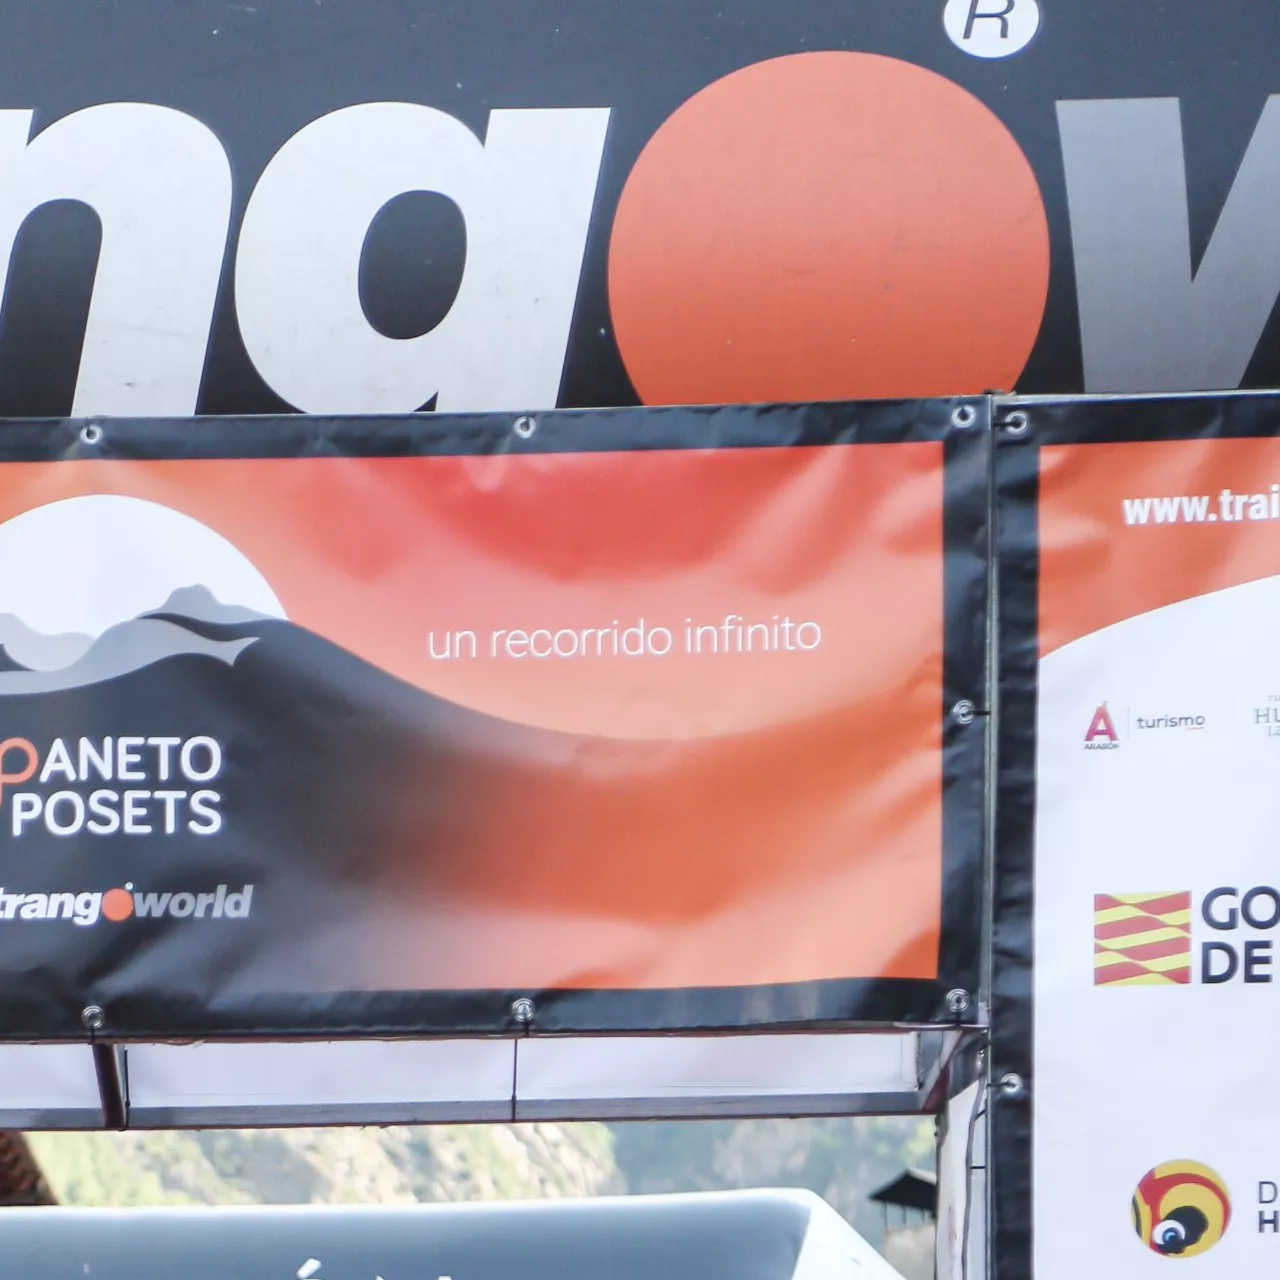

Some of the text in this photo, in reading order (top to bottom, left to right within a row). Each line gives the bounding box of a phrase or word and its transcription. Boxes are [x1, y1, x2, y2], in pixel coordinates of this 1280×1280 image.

[429, 615, 822, 660] un recorrido infinito
[1137, 715, 1206, 730] turismo
[40, 735, 222, 783] ANETO
[12, 789, 222, 837] POSETS
[1201, 938, 1273, 985] DE
